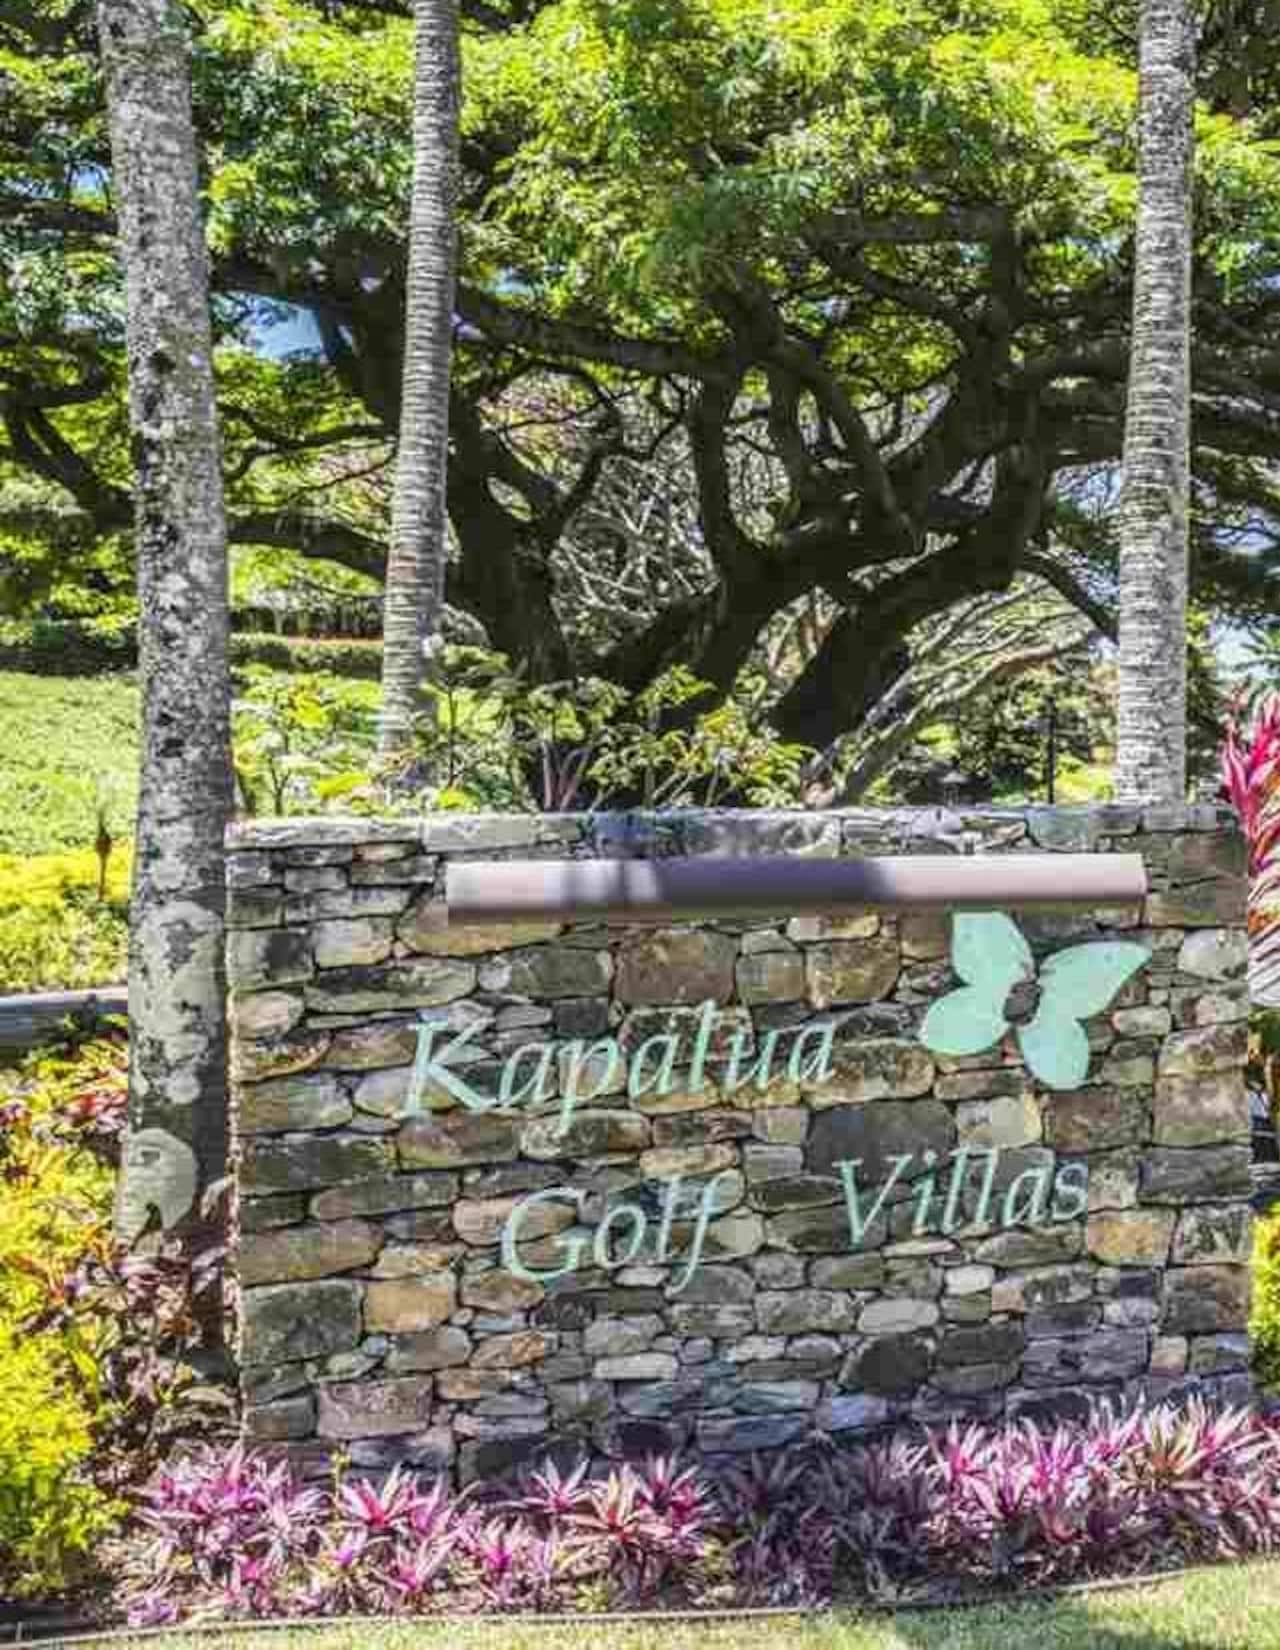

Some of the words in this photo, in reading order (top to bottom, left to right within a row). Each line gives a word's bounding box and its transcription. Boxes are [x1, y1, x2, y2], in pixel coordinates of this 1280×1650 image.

[400, 999, 836, 1137] Kapalua
[501, 1172, 741, 1297] Golf
[832, 1146, 1088, 1246] Villas
